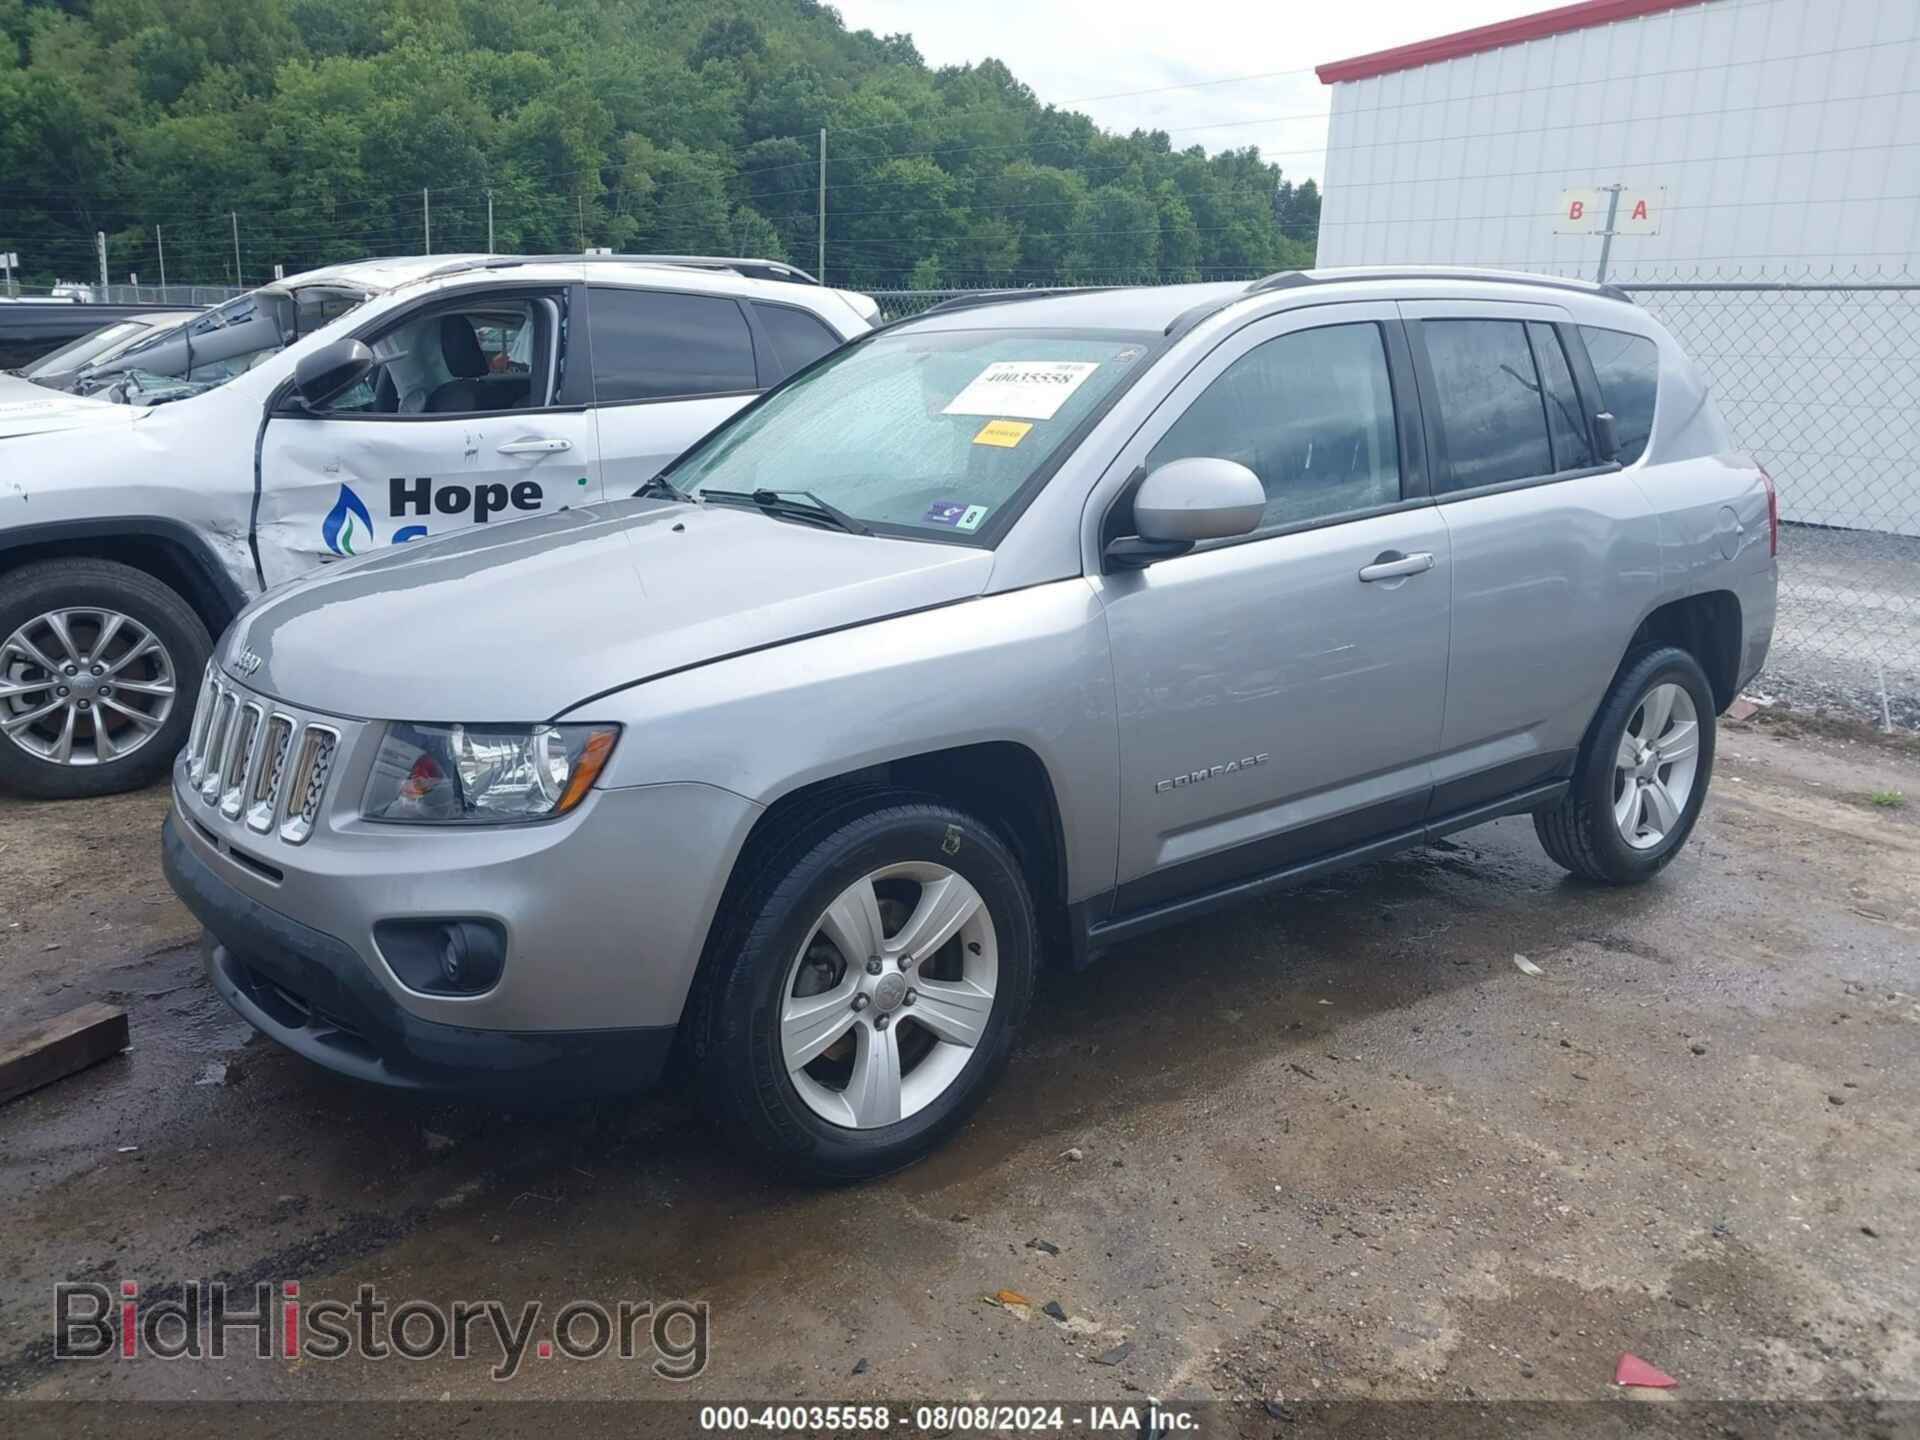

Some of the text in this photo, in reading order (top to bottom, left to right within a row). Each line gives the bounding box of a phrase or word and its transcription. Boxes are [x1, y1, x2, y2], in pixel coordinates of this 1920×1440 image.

[1569, 200, 1584, 221] B
[1631, 199, 1648, 221] A
[389, 477, 544, 523] Hope
